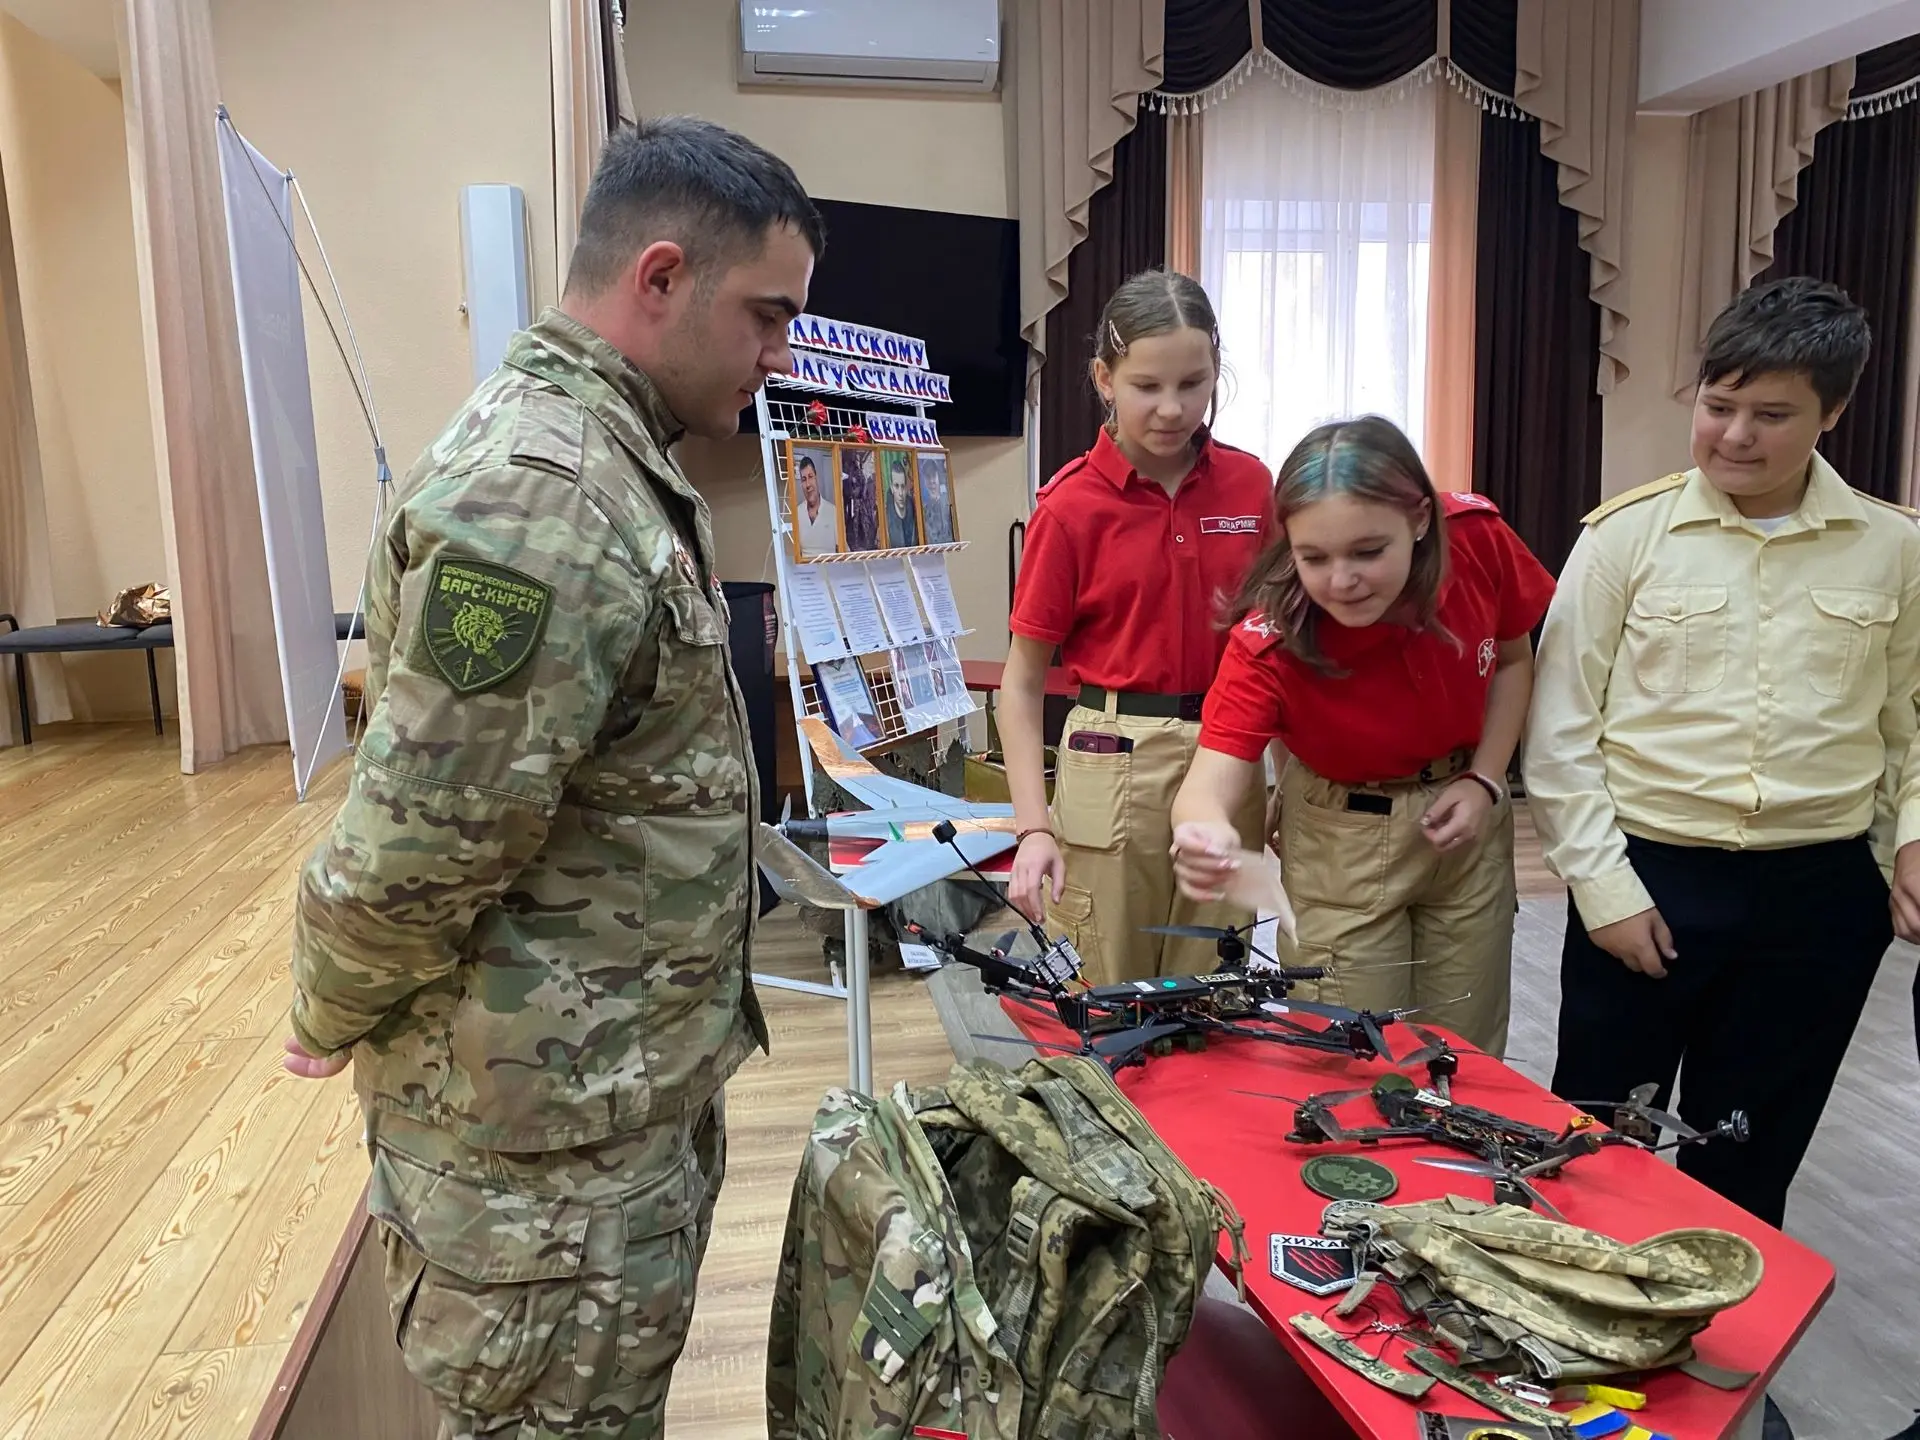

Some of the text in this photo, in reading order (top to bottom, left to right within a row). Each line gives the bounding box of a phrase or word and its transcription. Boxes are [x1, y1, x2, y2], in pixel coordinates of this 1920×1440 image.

[788, 317, 925, 365] ЛДАТСКОМУ
[847, 363, 949, 401] ОСТАЛИСЬ
[868, 414, 938, 445] ВЕРНЫ
